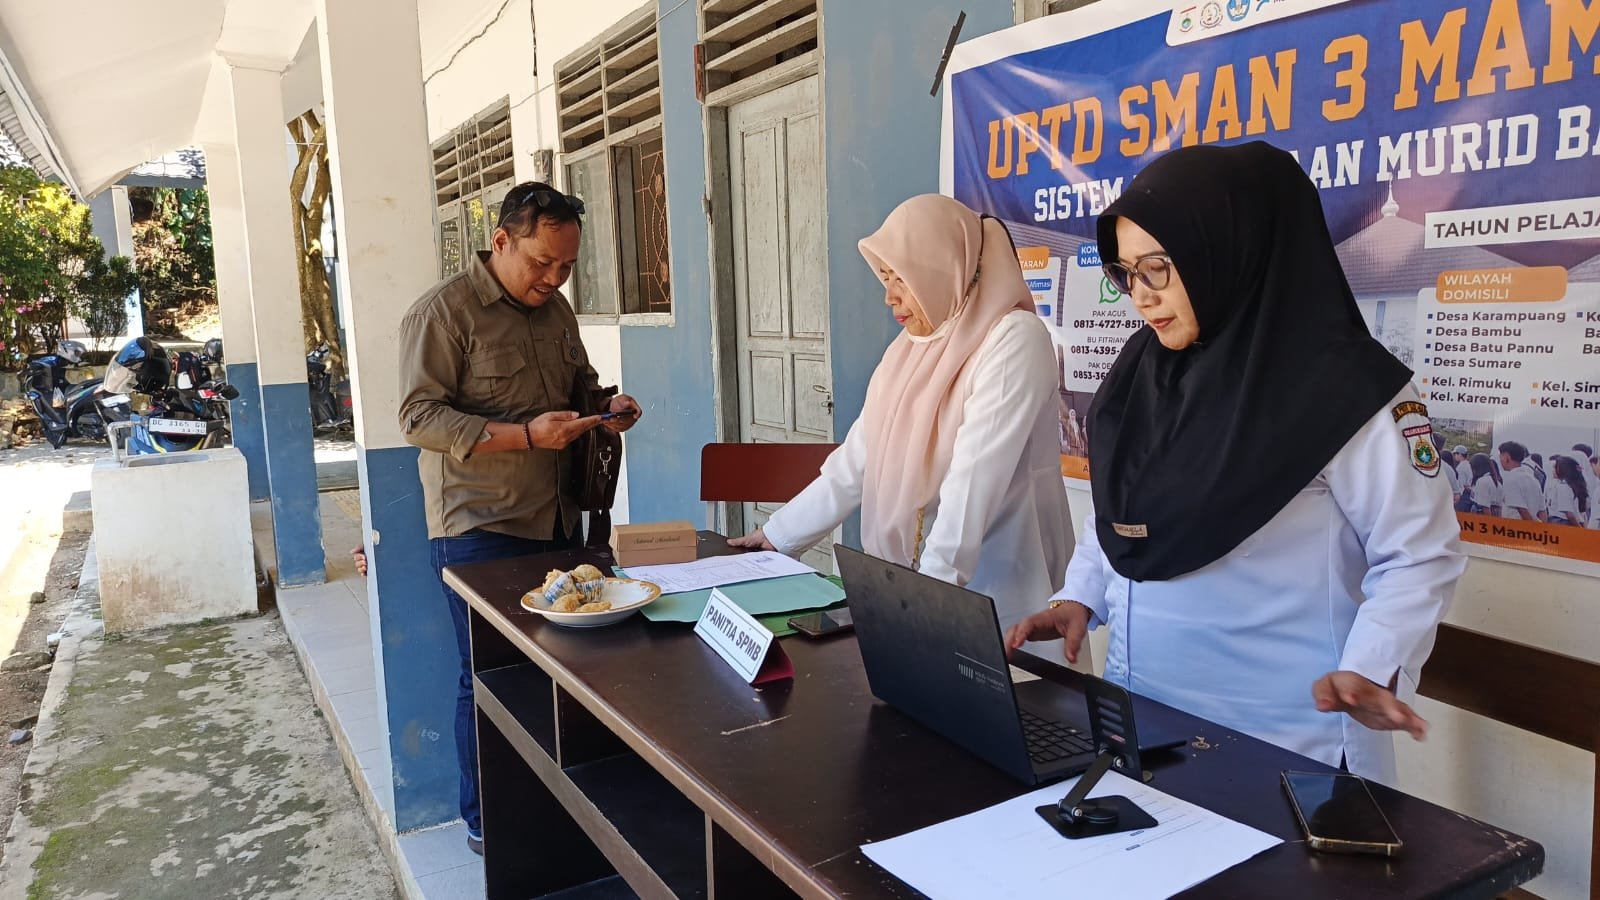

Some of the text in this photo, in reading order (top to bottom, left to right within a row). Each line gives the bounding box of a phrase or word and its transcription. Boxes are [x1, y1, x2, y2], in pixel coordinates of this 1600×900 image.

[986, 96, 1104, 180] UPTD
[1118, 48, 1298, 158] SMAN
[1321, 33, 1369, 122] 3
[1034, 104, 1600, 223] SISTEM AN MURID B
[1433, 217, 1510, 239] TAHUN
[1444, 272, 1512, 286] WILAYAH
[1443, 288, 1509, 301] DOMISILI
[1436, 311, 1566, 323] Desa Karampuang
[1435, 326, 1522, 338] Desa Bambu
[1434, 342, 1554, 354] Desa Batu Pannu
[1088, 361, 1100, 369] PAK
[1433, 357, 1522, 369] Desa Sumare
[1431, 376, 1511, 389] Kel. Rimuku
[1542, 380, 1570, 392] Kel.
[1430, 391, 1509, 405] Kel. Karema
[1540, 396, 1569, 409] Kel.
[1480, 523, 1488, 534] 3
[1492, 524, 1560, 545] Mamuju
[705, 605, 763, 663] PANITIA SPMB
